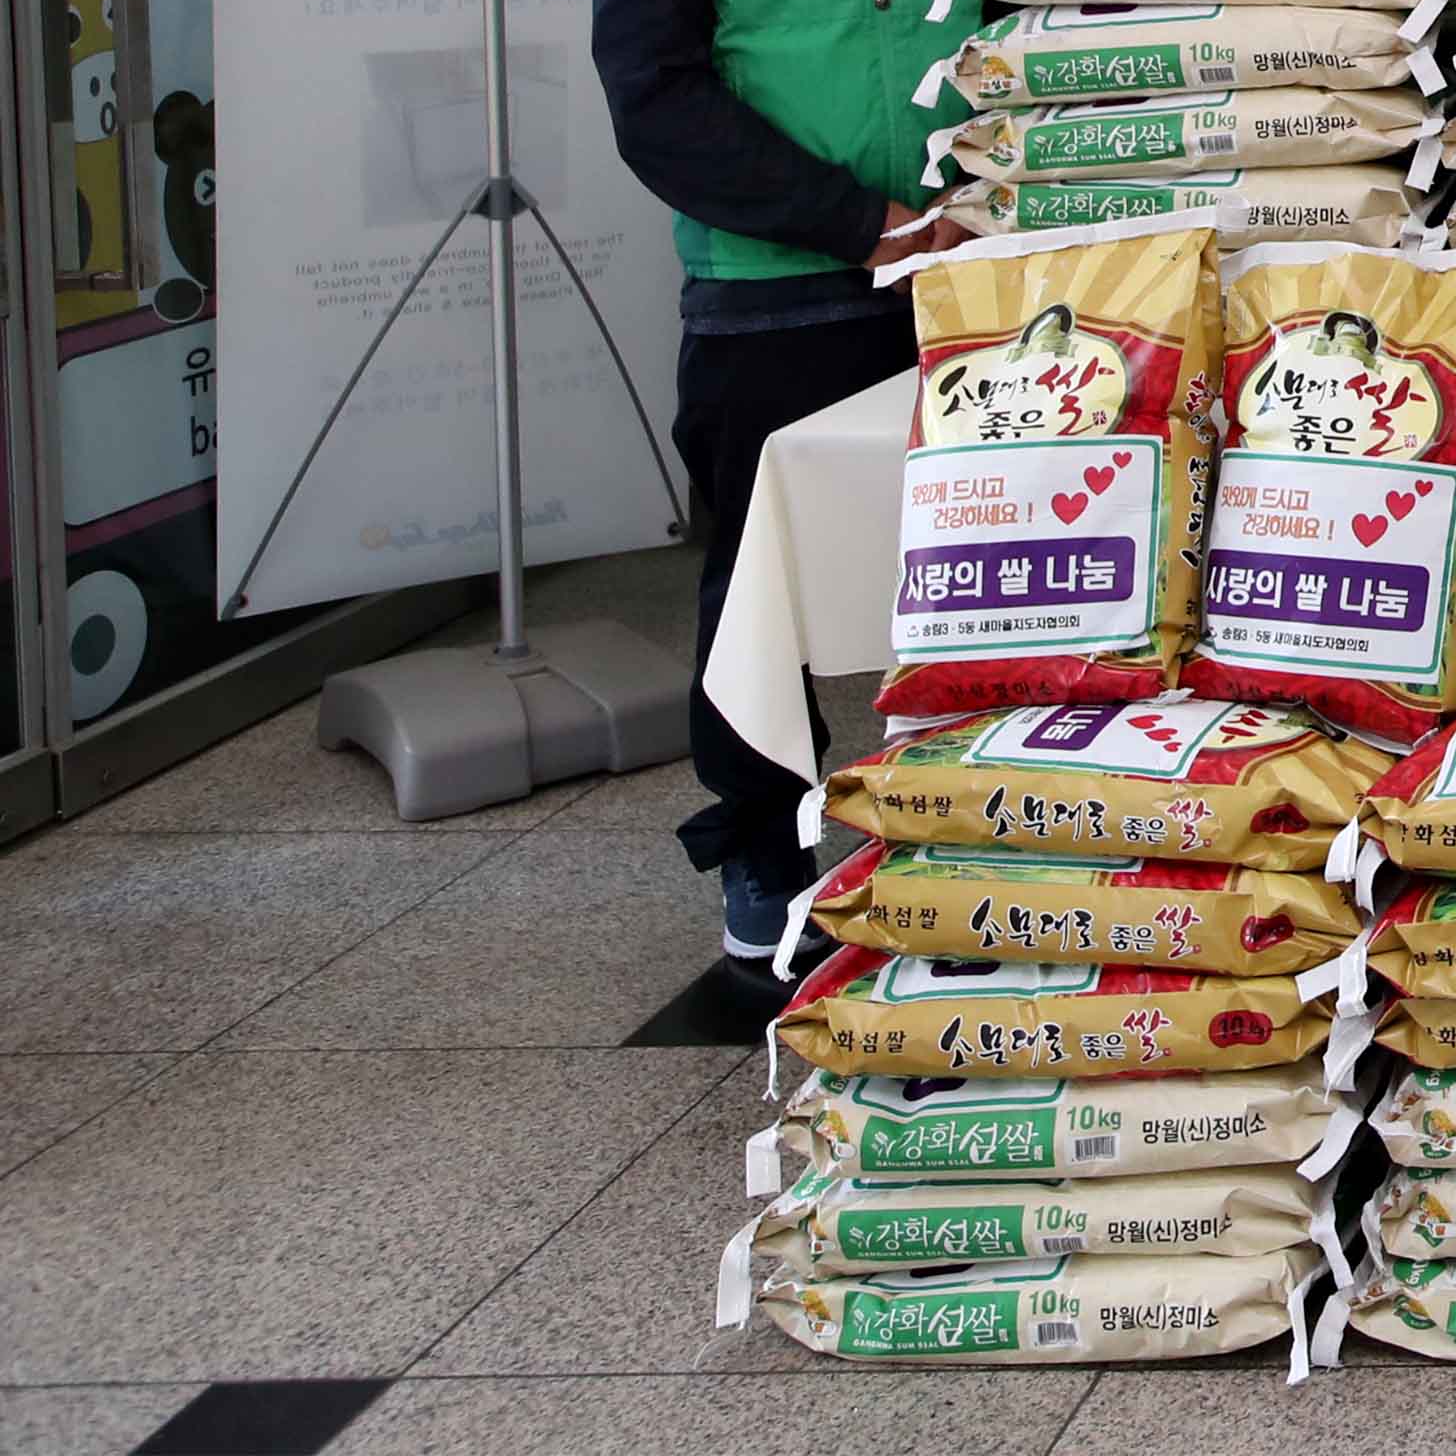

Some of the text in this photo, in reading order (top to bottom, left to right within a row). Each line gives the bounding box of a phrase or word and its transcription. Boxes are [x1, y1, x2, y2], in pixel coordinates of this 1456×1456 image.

[1289, 414, 1358, 456] 좋은
[905, 552, 1117, 601] 사랑의 쌀 나눔
[1206, 565, 1411, 621] 사랑의 쌀 나눔
[1121, 815, 1166, 845] 좋은
[1165, 798, 1217, 853] 쌀
[1065, 1103, 1123, 1131] 10kg
[1141, 1113, 1267, 1144] 망월(신)정미소
[898, 1119, 1039, 1165] 강화섬쌀
